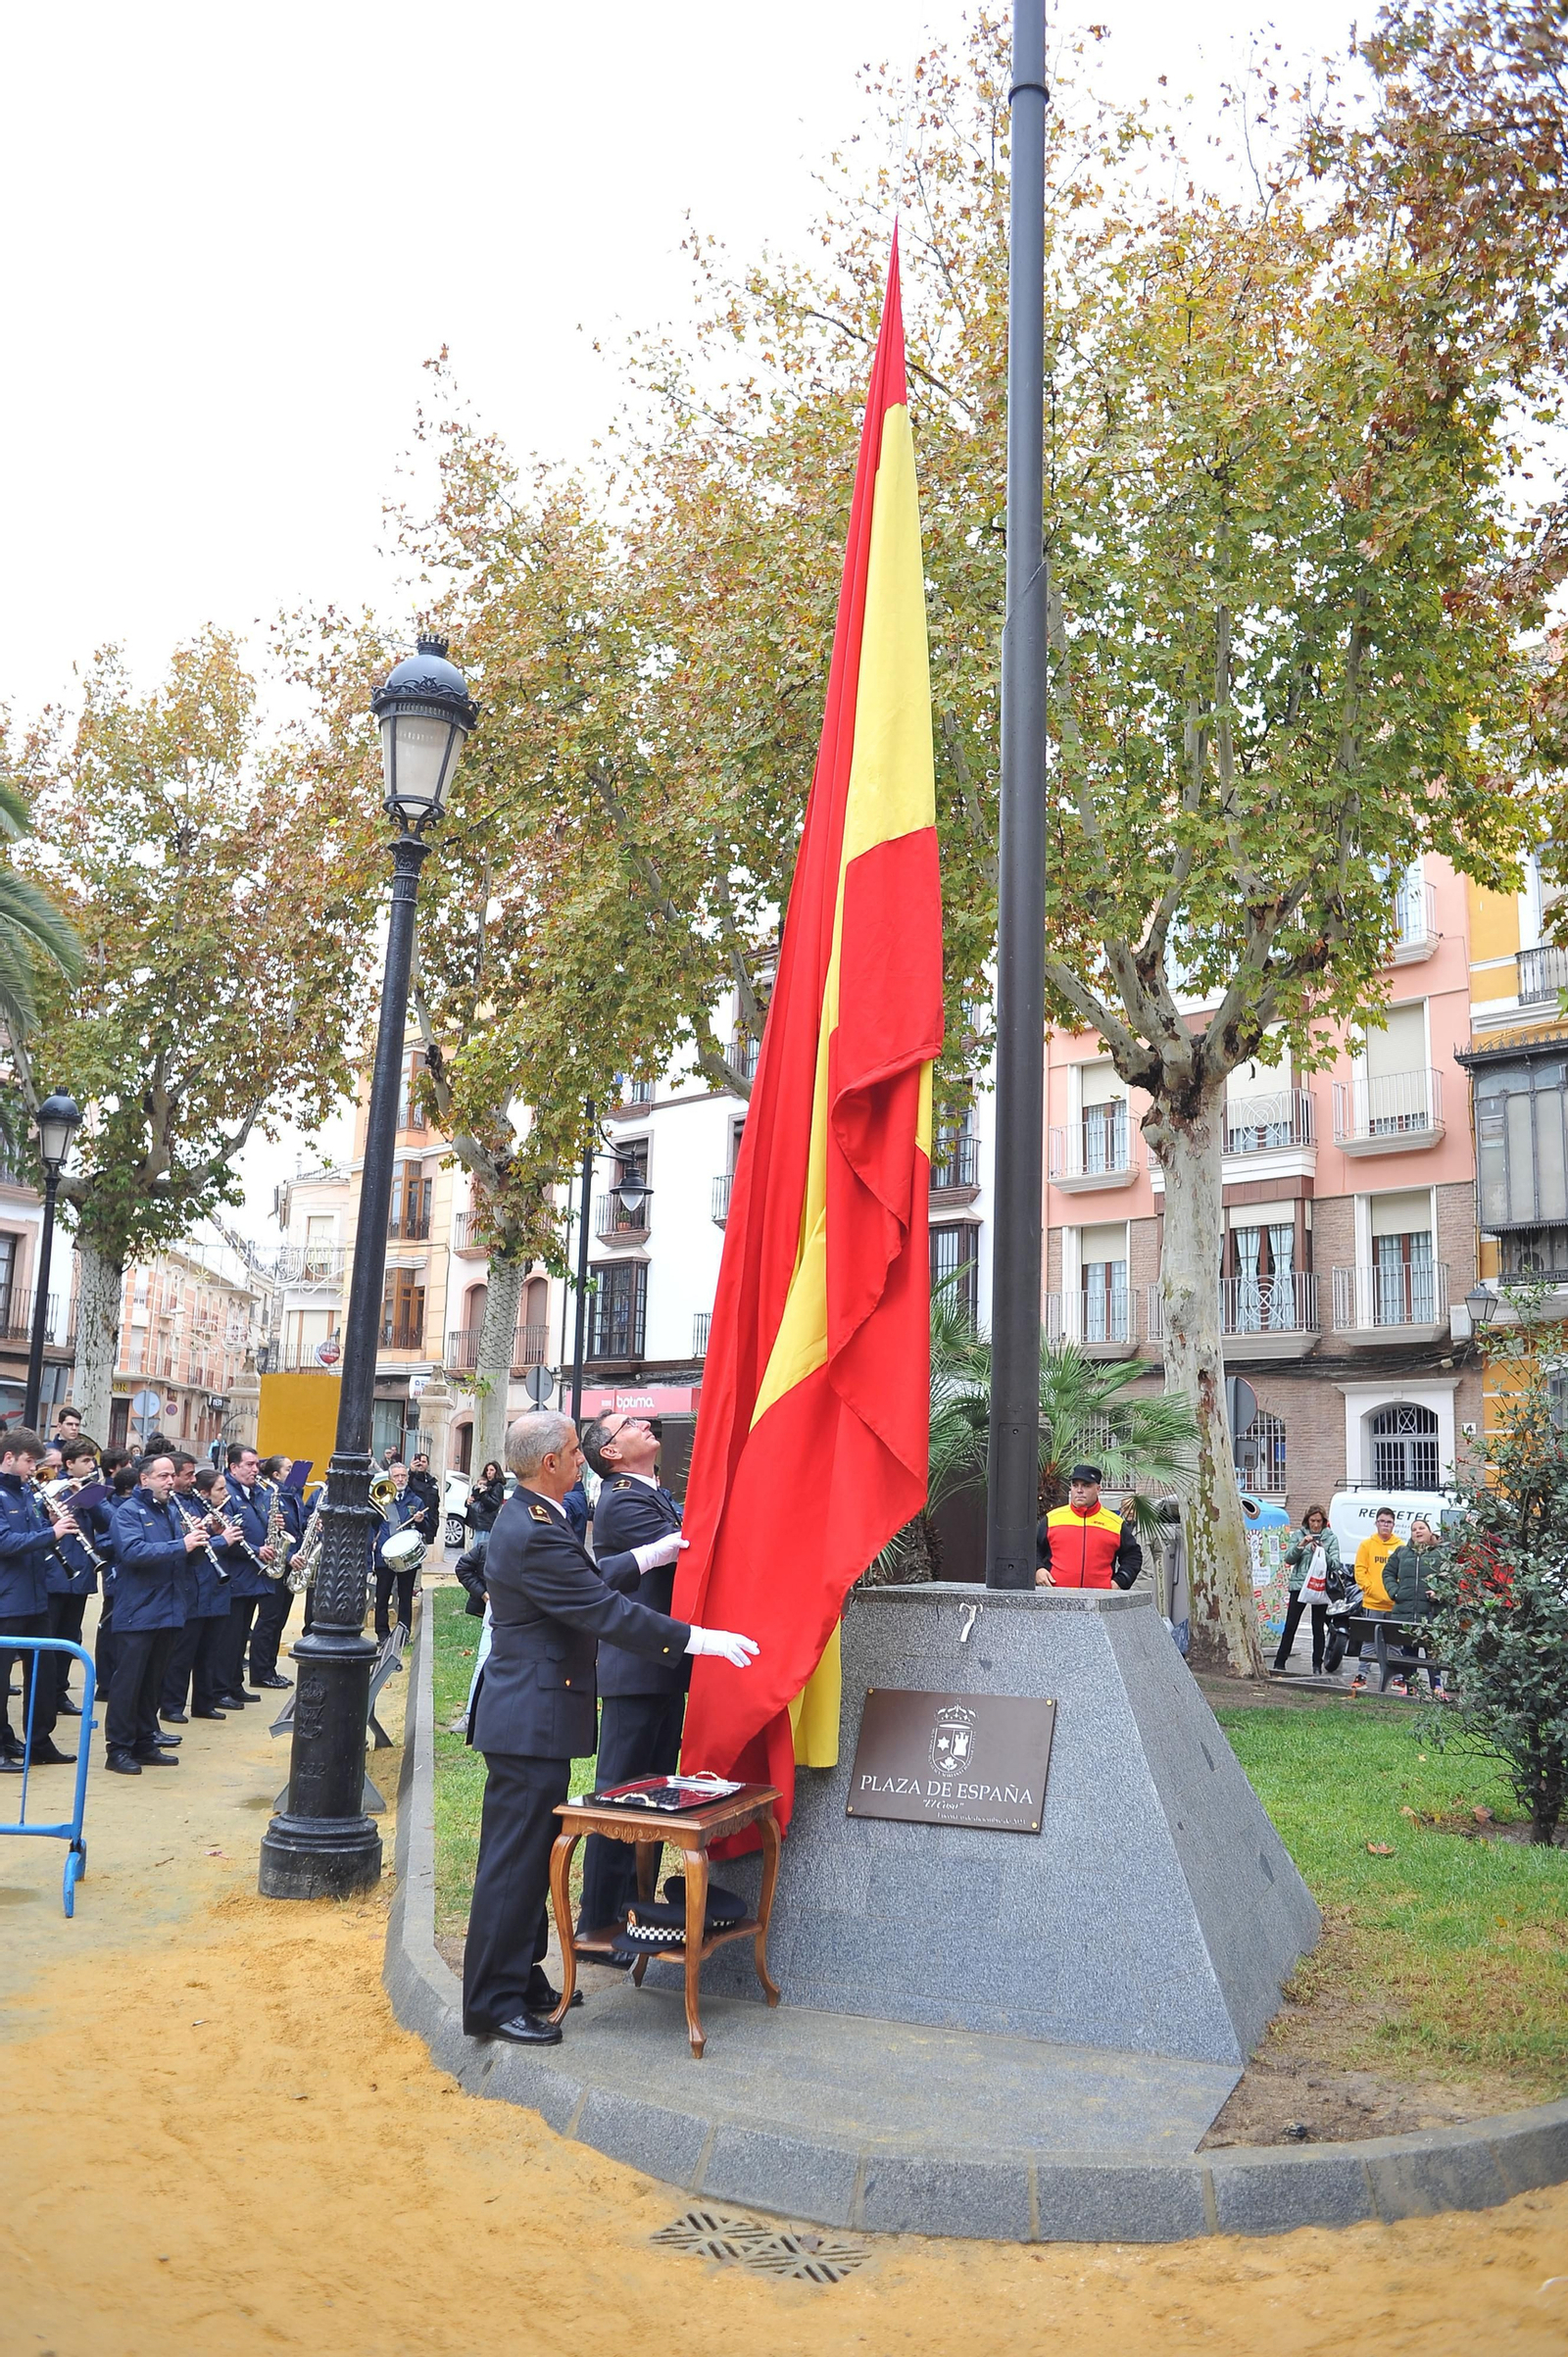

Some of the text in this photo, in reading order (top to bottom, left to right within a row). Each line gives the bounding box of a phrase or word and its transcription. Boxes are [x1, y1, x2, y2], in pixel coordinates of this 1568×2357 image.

[1358, 1508, 1433, 1523] REETEC
[859, 1774, 1034, 1805] PLAZA DE ESPAÑA
